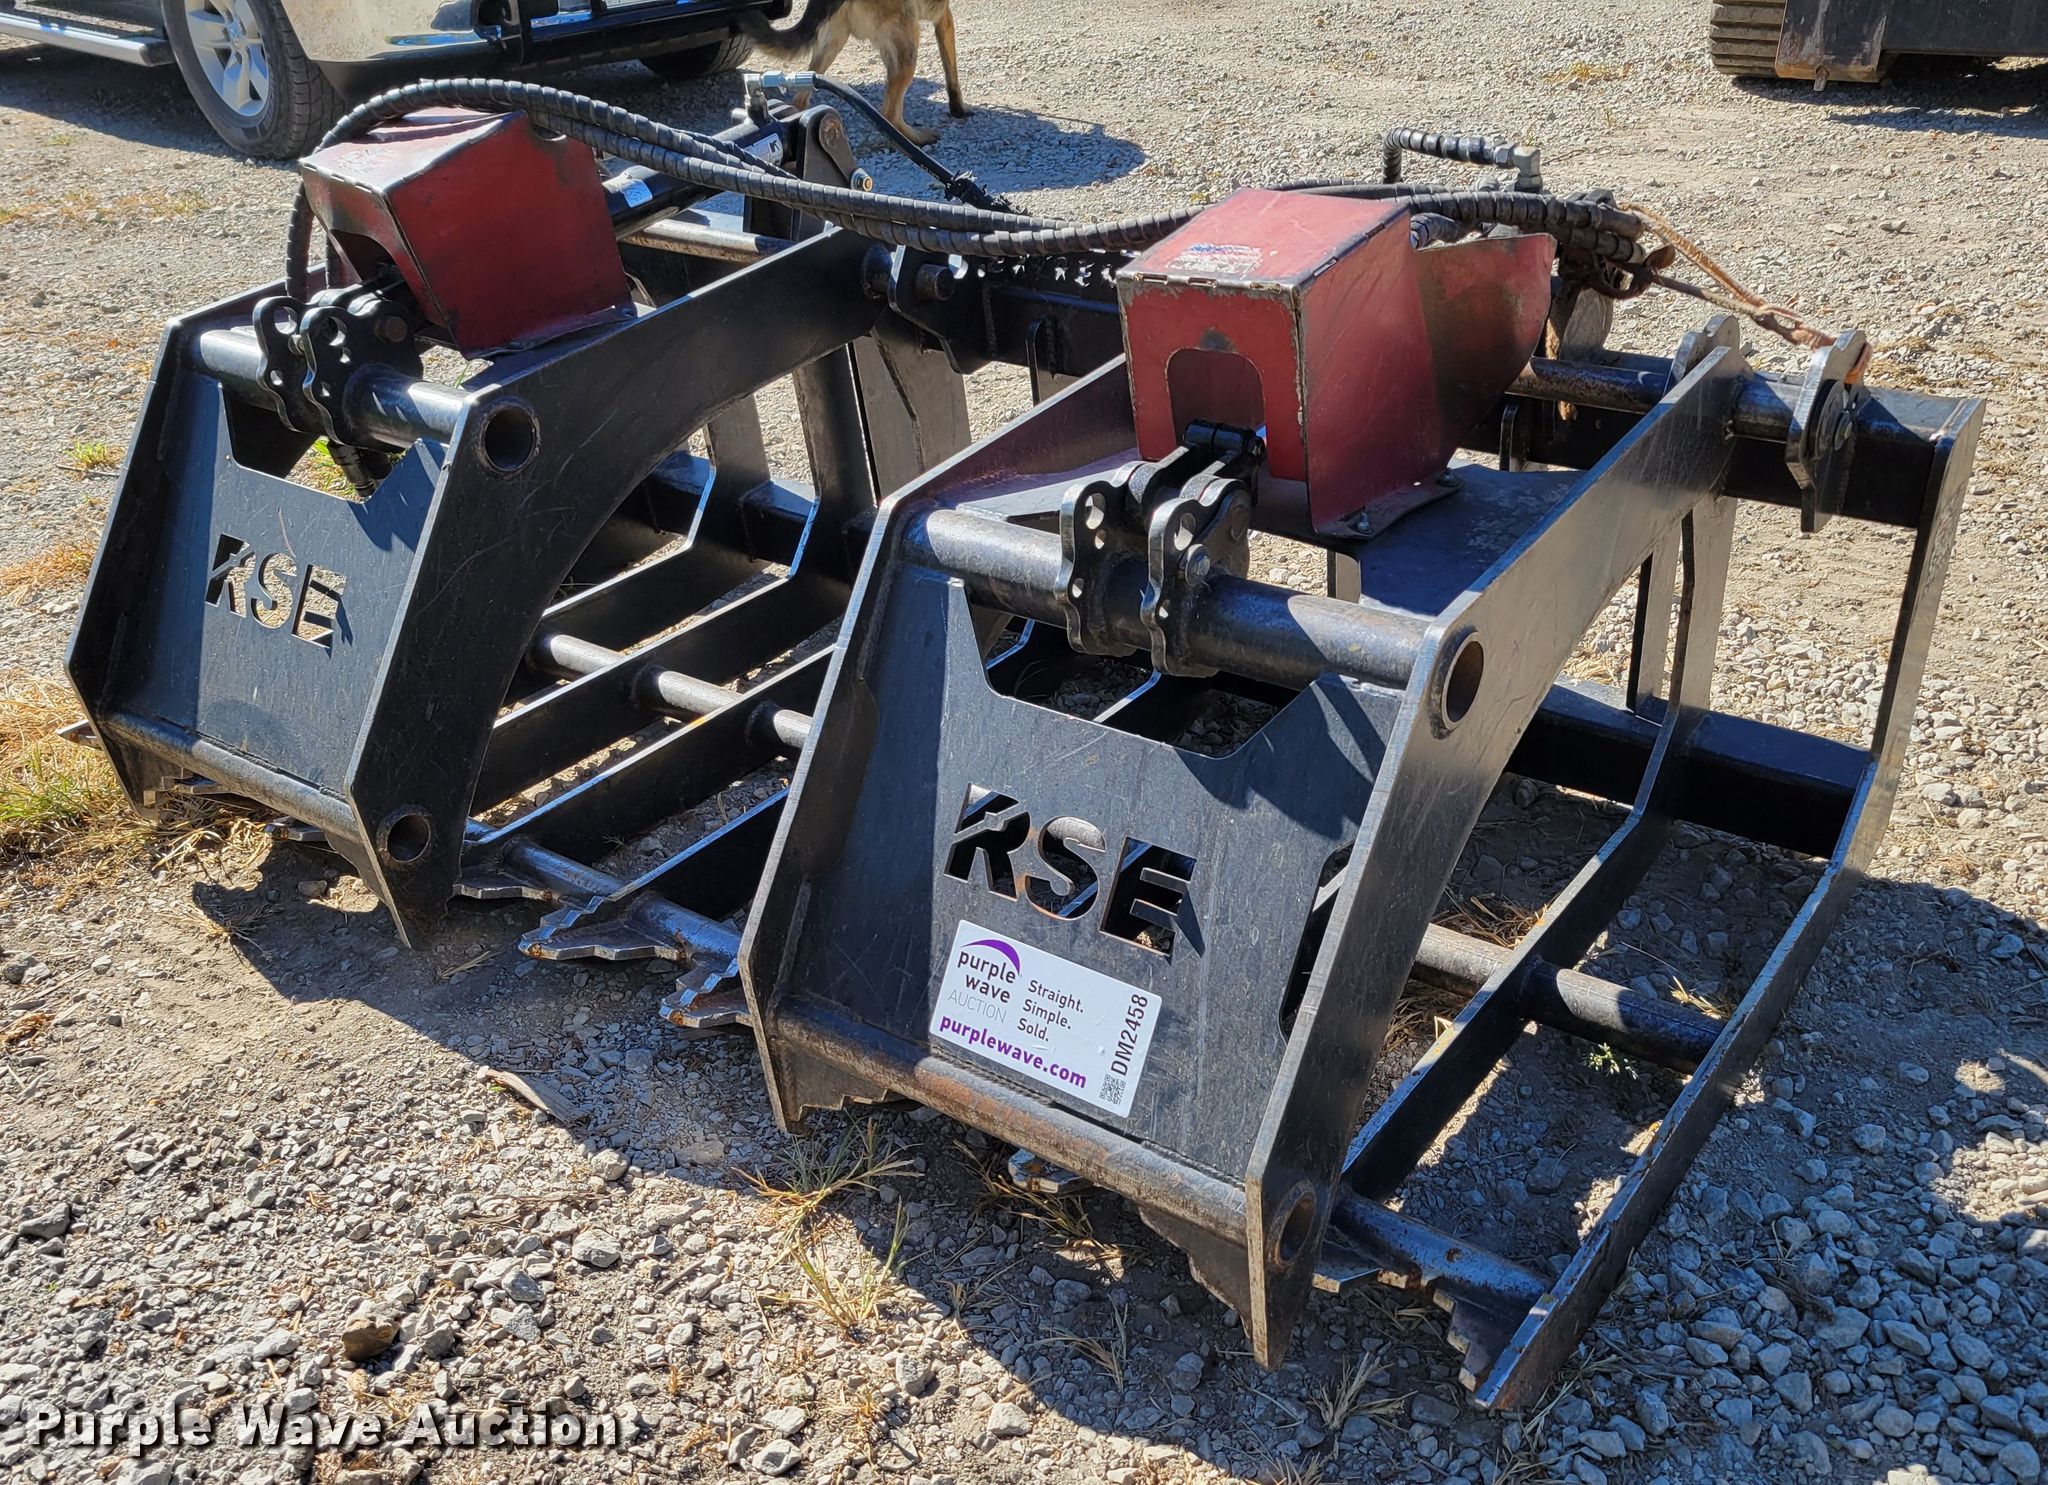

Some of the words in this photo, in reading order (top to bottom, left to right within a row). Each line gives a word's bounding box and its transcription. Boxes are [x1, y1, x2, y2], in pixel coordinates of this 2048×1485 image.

[944, 783, 1197, 957] RSE
[957, 950, 1017, 984] purple
[948, 988, 1007, 1024] AUCTION
[964, 974, 1011, 1004] wave
[1028, 980, 1084, 1014] Straight.
[1017, 1018, 1049, 1042] Sold.
[1022, 999, 1071, 1030] Simple.
[1110, 993, 1148, 1076] DM2458
[939, 1015, 1087, 1089] purplewave.com
